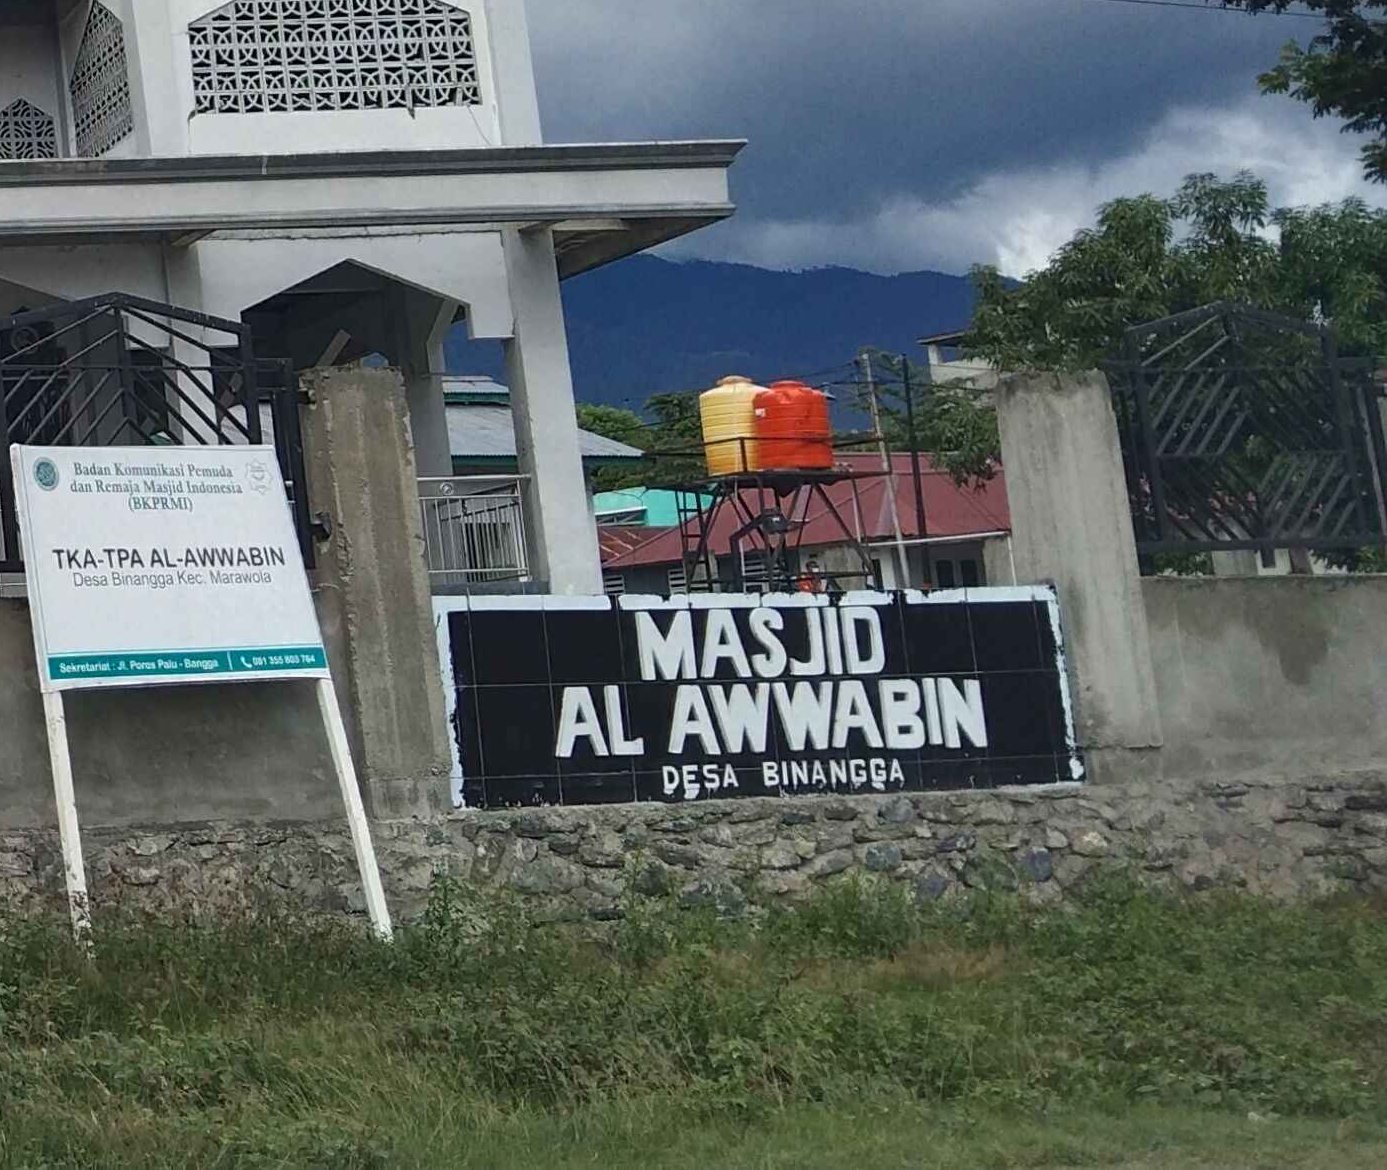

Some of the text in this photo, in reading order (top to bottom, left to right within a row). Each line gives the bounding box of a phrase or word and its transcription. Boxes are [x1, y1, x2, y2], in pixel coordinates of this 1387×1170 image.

[74, 463, 233, 479] Badan Komunikasi Pemuda
[69, 480, 243, 497] dan Remaja Masjid Indonesia
[128, 497, 194, 513] (BKPRMI)
[52, 547, 286, 570] TKA-TPA AL-AWWABIN
[73, 571, 108, 587] Desa
[112, 571, 175, 589] Binangga
[211, 569, 272, 584] Marawola
[634, 606, 885, 680] MASJID
[60, 661, 111, 673] Sekretariat
[158, 658, 178, 669] Palu
[184, 658, 220, 670] Bangga
[555, 678, 988, 758] AL AWWABIN
[663, 757, 905, 792] DESA BINANGGA
